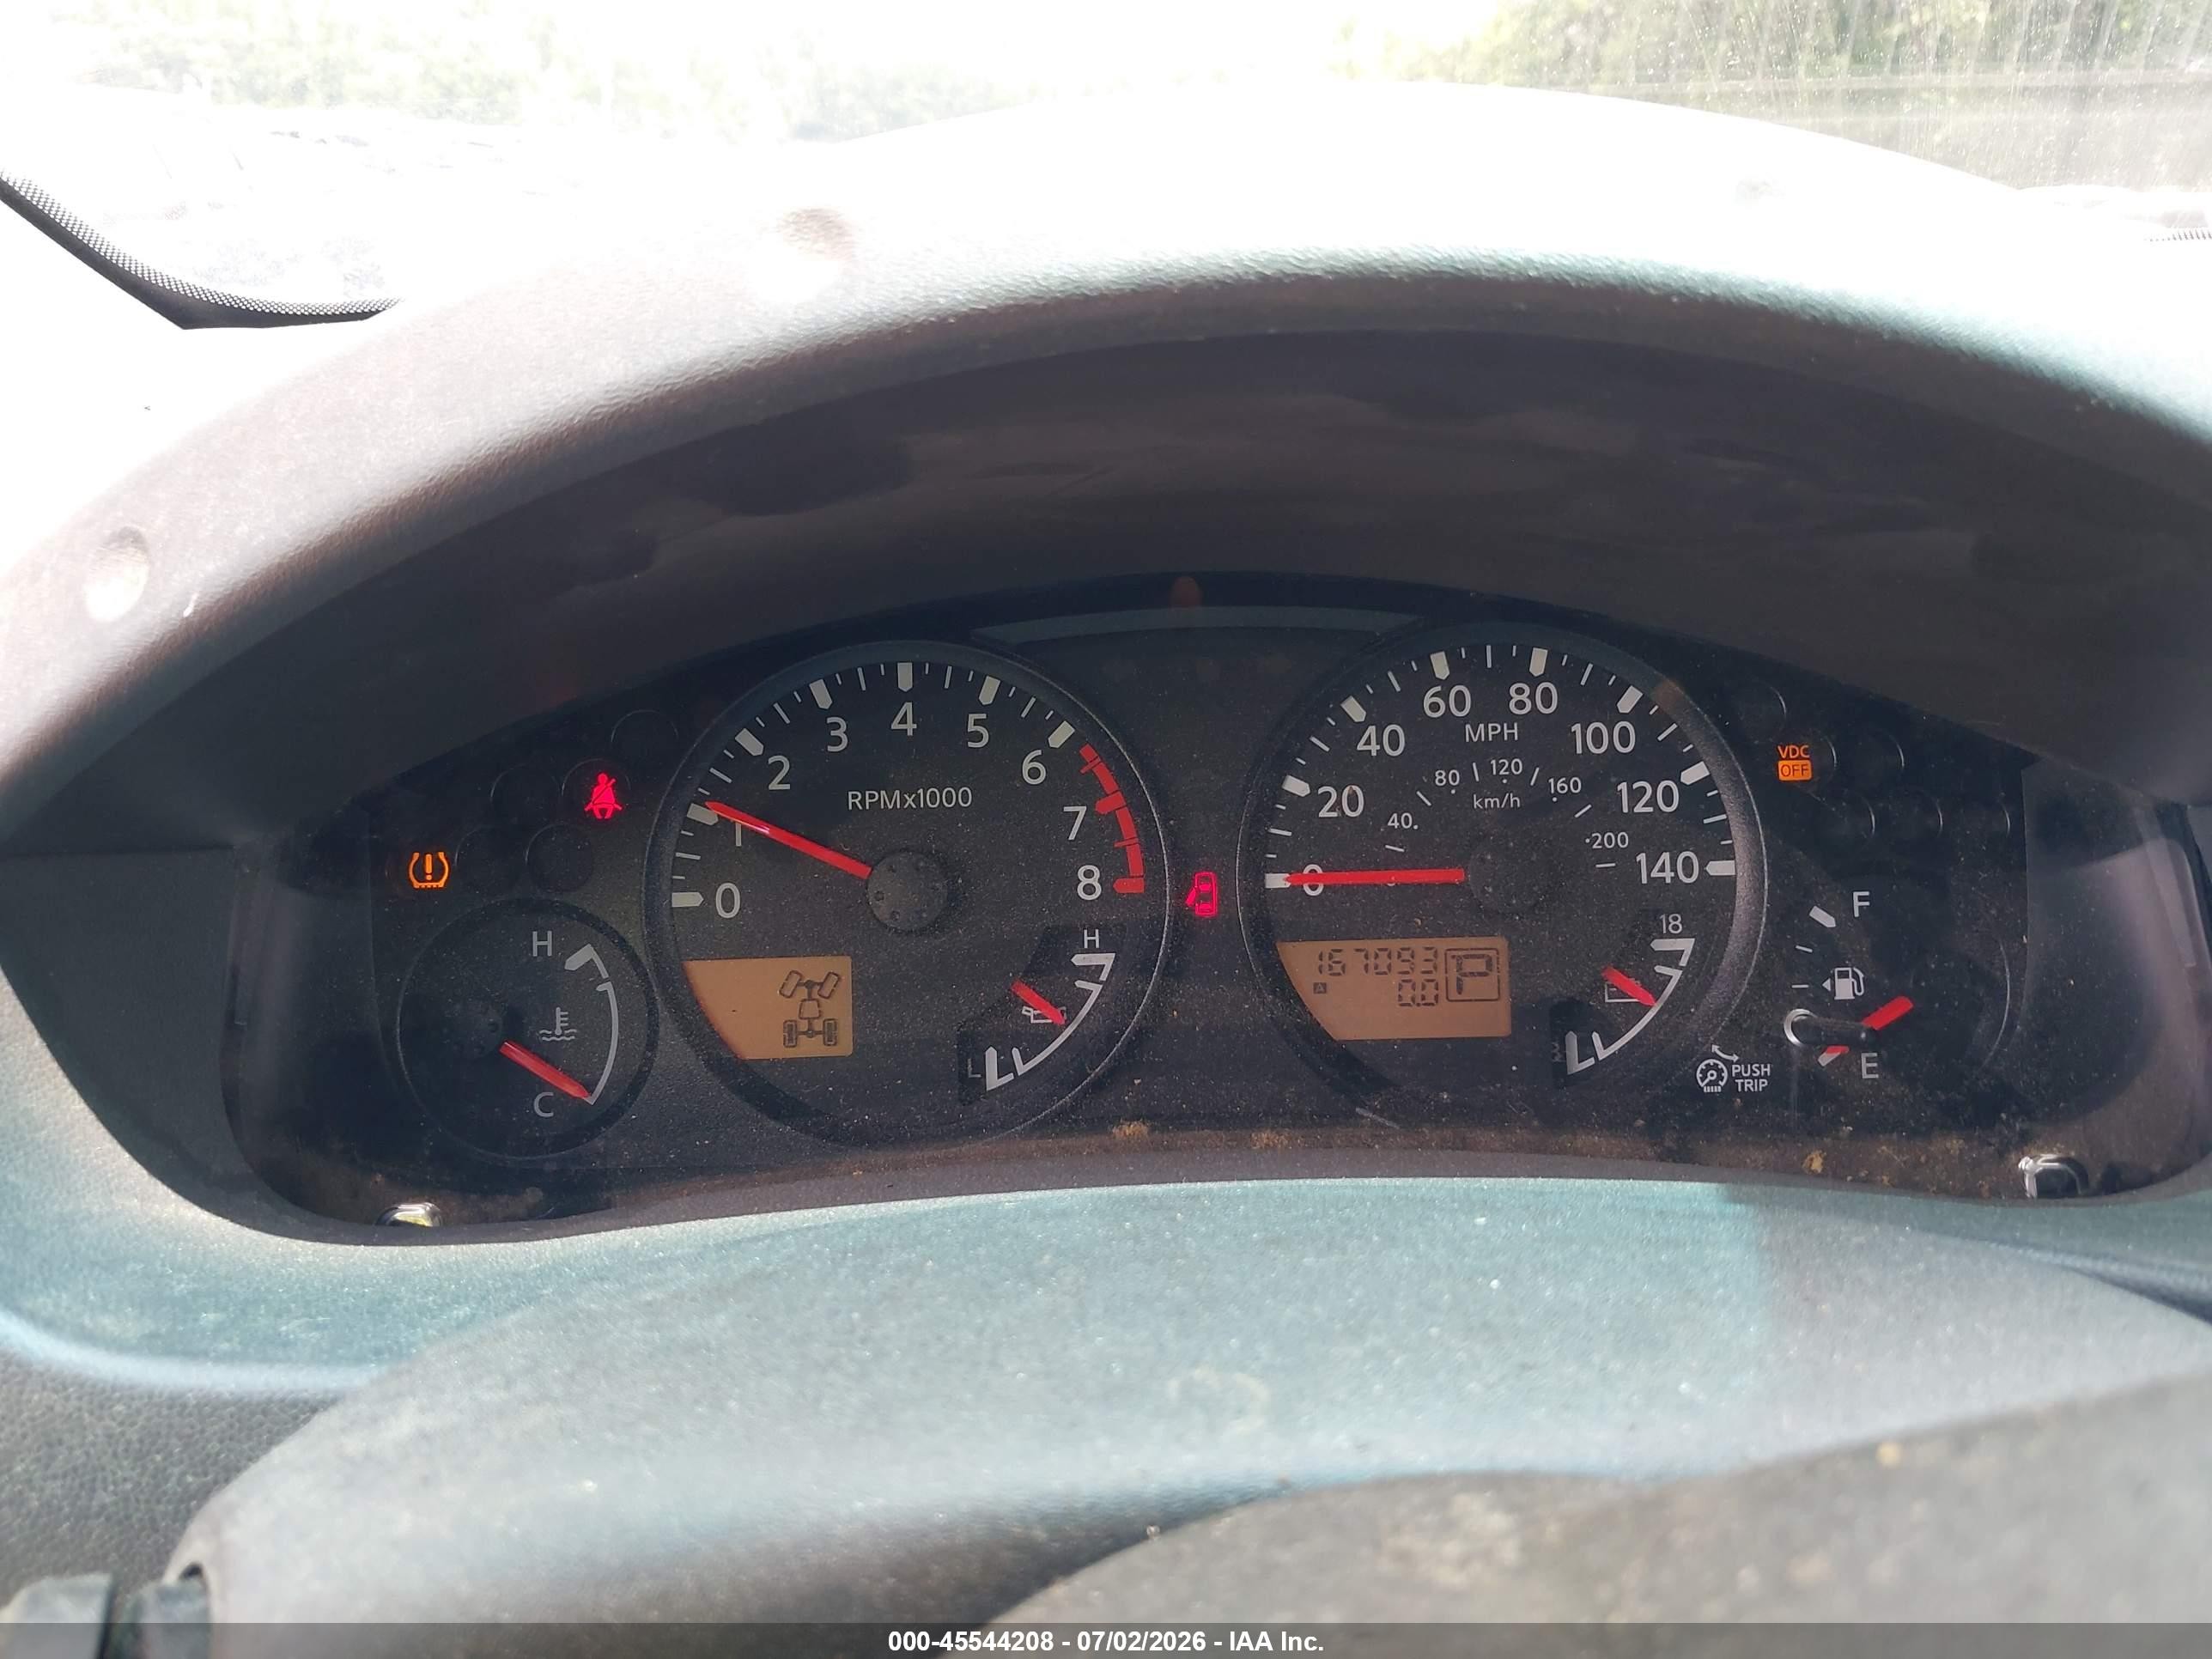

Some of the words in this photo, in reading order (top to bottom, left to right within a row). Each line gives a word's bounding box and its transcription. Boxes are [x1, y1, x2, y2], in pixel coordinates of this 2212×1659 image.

[1423, 684, 1472, 717] 60
[1509, 682, 1559, 714] 80
[890, 702, 917, 736] 4
[967, 713, 989, 748] 5
[1464, 722, 1519, 743] MPH
[826, 716, 848, 752] 3
[1356, 725, 1406, 757] 40
[1571, 720, 1636, 754] 100
[1778, 744, 1810, 758] VDC
[768, 755, 791, 790] 2
[1022, 750, 1047, 785] 6
[1434, 769, 1461, 787] 80
[1490, 758, 1523, 775] 120
[1780, 763, 1809, 777] OFF
[848, 787, 973, 810] RPMx1000
[1548, 777, 1582, 793] 160
[1617, 780, 1680, 813] 120
[1317, 785, 1364, 817] 20
[1473, 793, 1521, 809] km/h
[1063, 805, 1087, 841] 7
[1387, 812, 1413, 830] 40
[1591, 831, 1629, 849] 200
[1636, 851, 1699, 884] 140
[1077, 865, 1102, 901] 8
[715, 882, 741, 919] 0
[1852, 890, 1870, 918] F
[1660, 913, 1683, 934] 18
[532, 930, 552, 957] H
[1083, 928, 1100, 949] H
[1318, 947, 1438, 976] 167093
[1450, 953, 1492, 995] P
[1397, 979, 1439, 1006] 0.0
[1730, 1063, 1771, 1079] PUSH
[1861, 1052, 1880, 1079] E
[1734, 1078, 1769, 1093] TRIP
[533, 1091, 554, 1118] C
